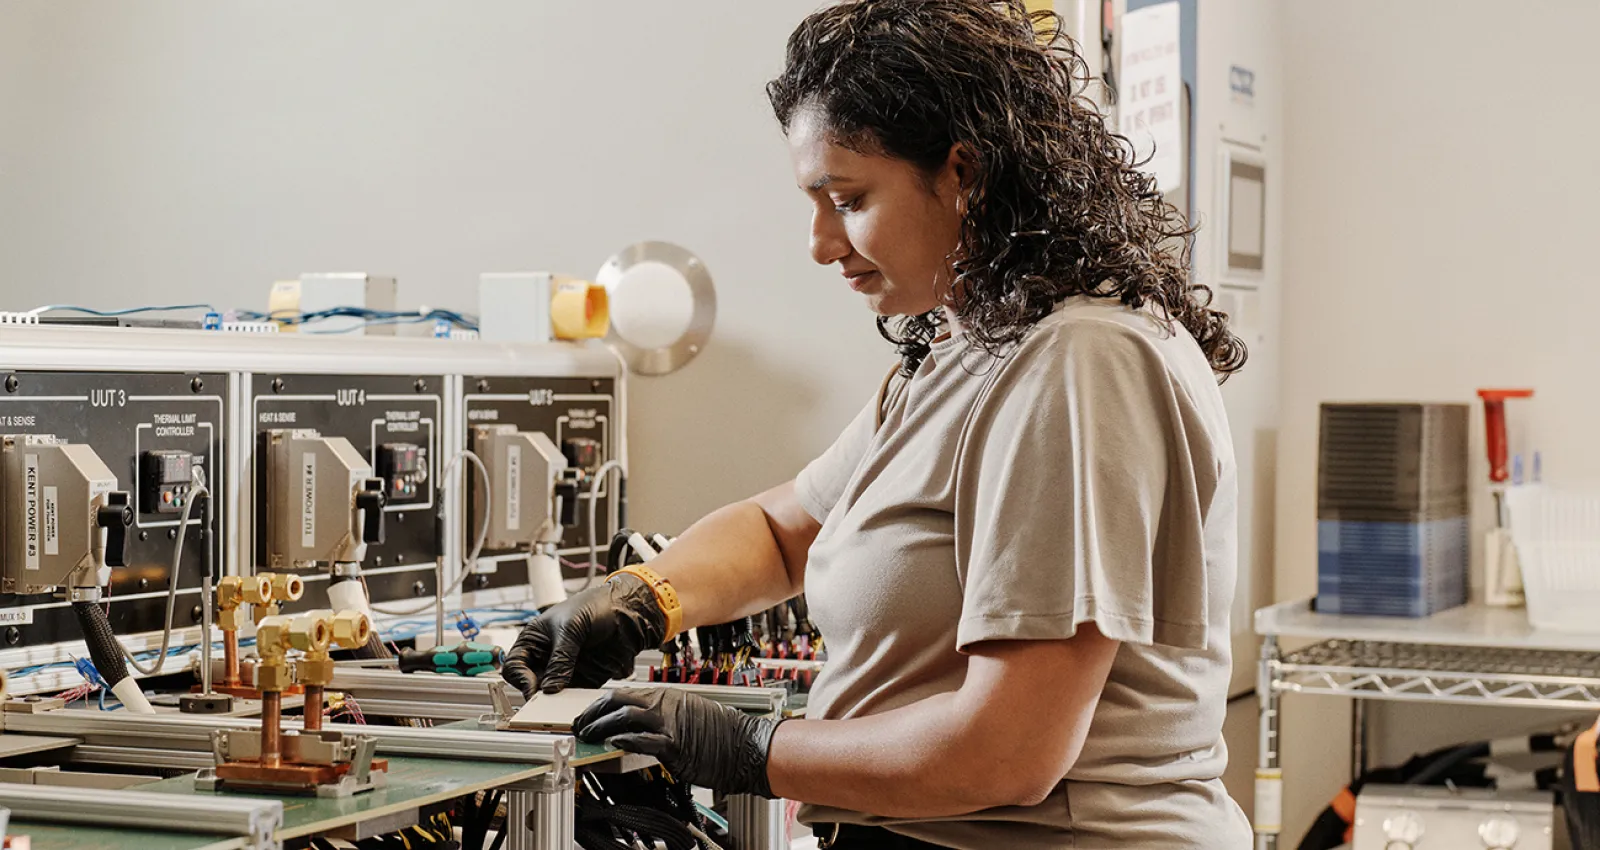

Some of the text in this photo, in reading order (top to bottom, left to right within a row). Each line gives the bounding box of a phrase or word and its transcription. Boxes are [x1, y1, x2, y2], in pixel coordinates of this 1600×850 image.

[91, 389, 126, 407] UUT 3
[337, 389, 366, 406] UUT 4
[13, 416, 36, 427] SENSE
[153, 413, 181, 424] THERMAL
[155, 426, 195, 437] CONTROLLER
[304, 478, 313, 514] POWER
[27, 466, 37, 557] KENT POWER #3
[304, 516, 313, 535] TUT
